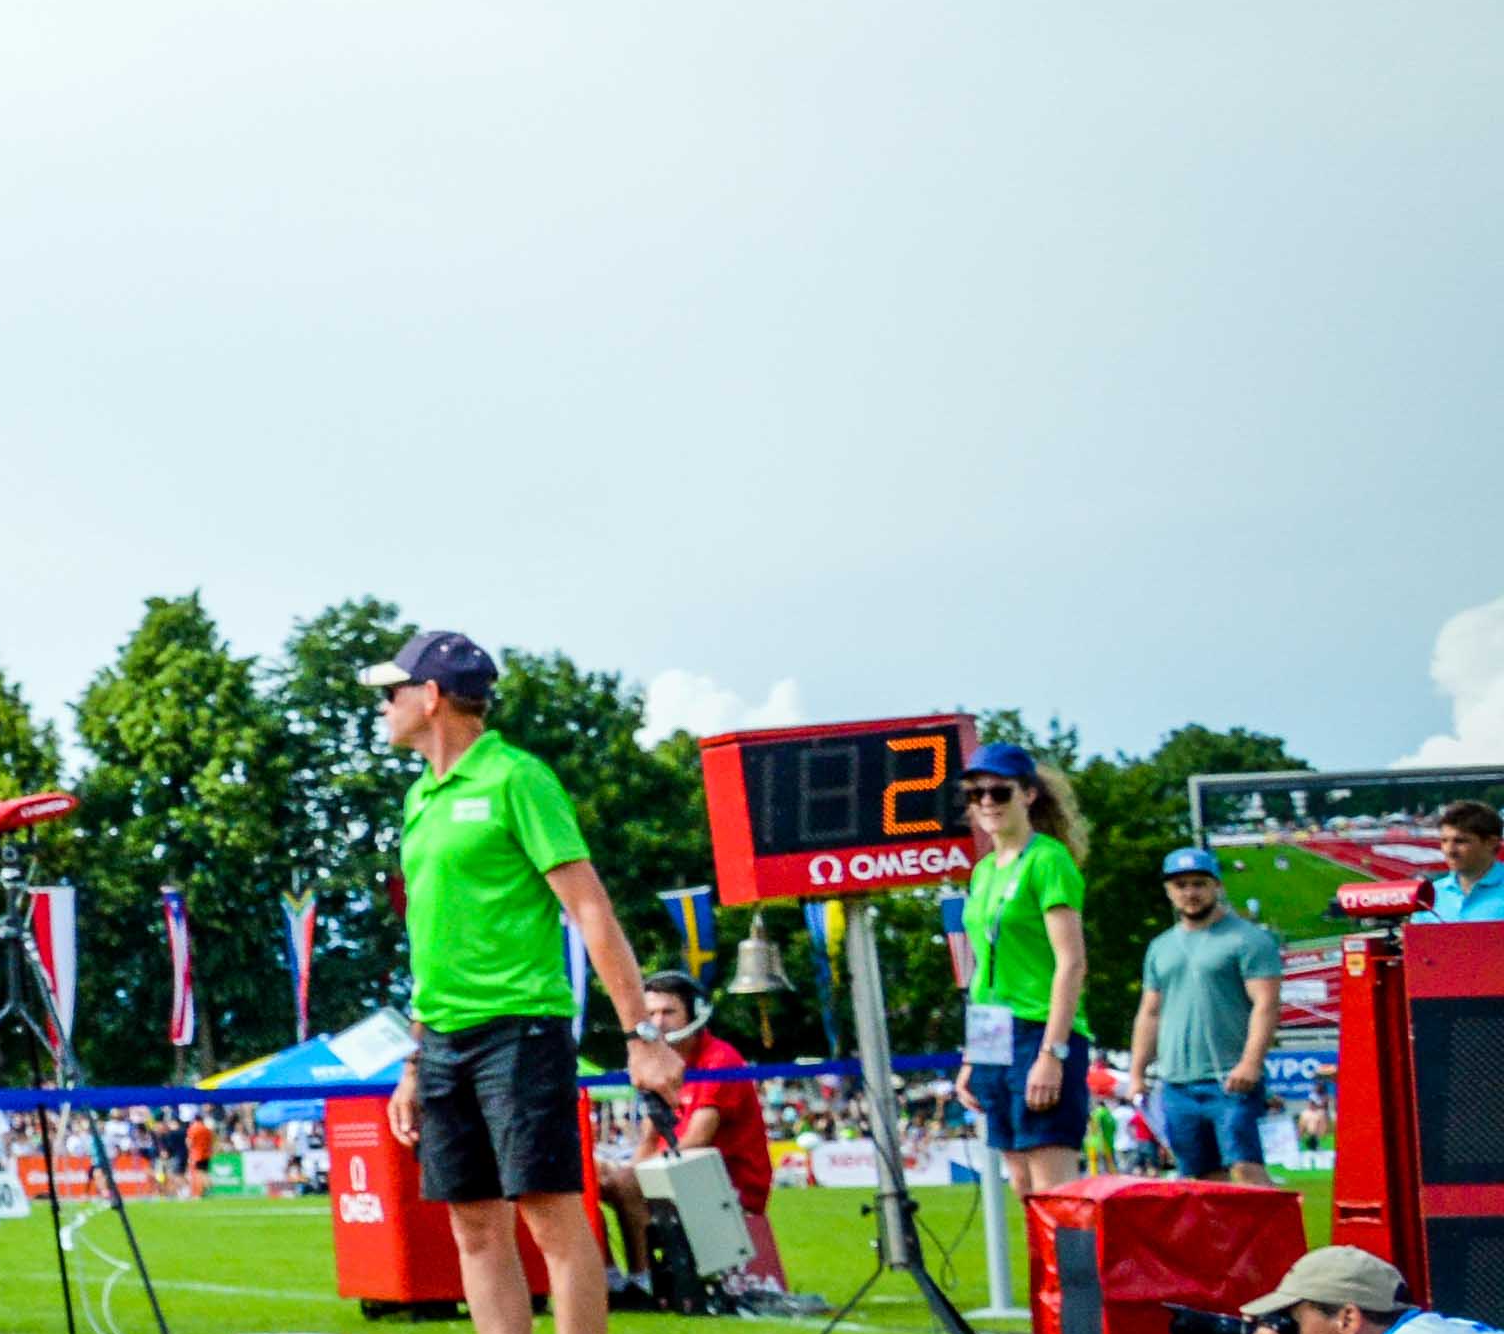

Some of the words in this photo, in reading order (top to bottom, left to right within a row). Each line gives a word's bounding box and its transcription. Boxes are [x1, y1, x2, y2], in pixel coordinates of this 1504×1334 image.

[882, 735, 947, 836] 2
[849, 846, 972, 878] OMEGA
[1264, 1057, 1319, 1079] YPO
